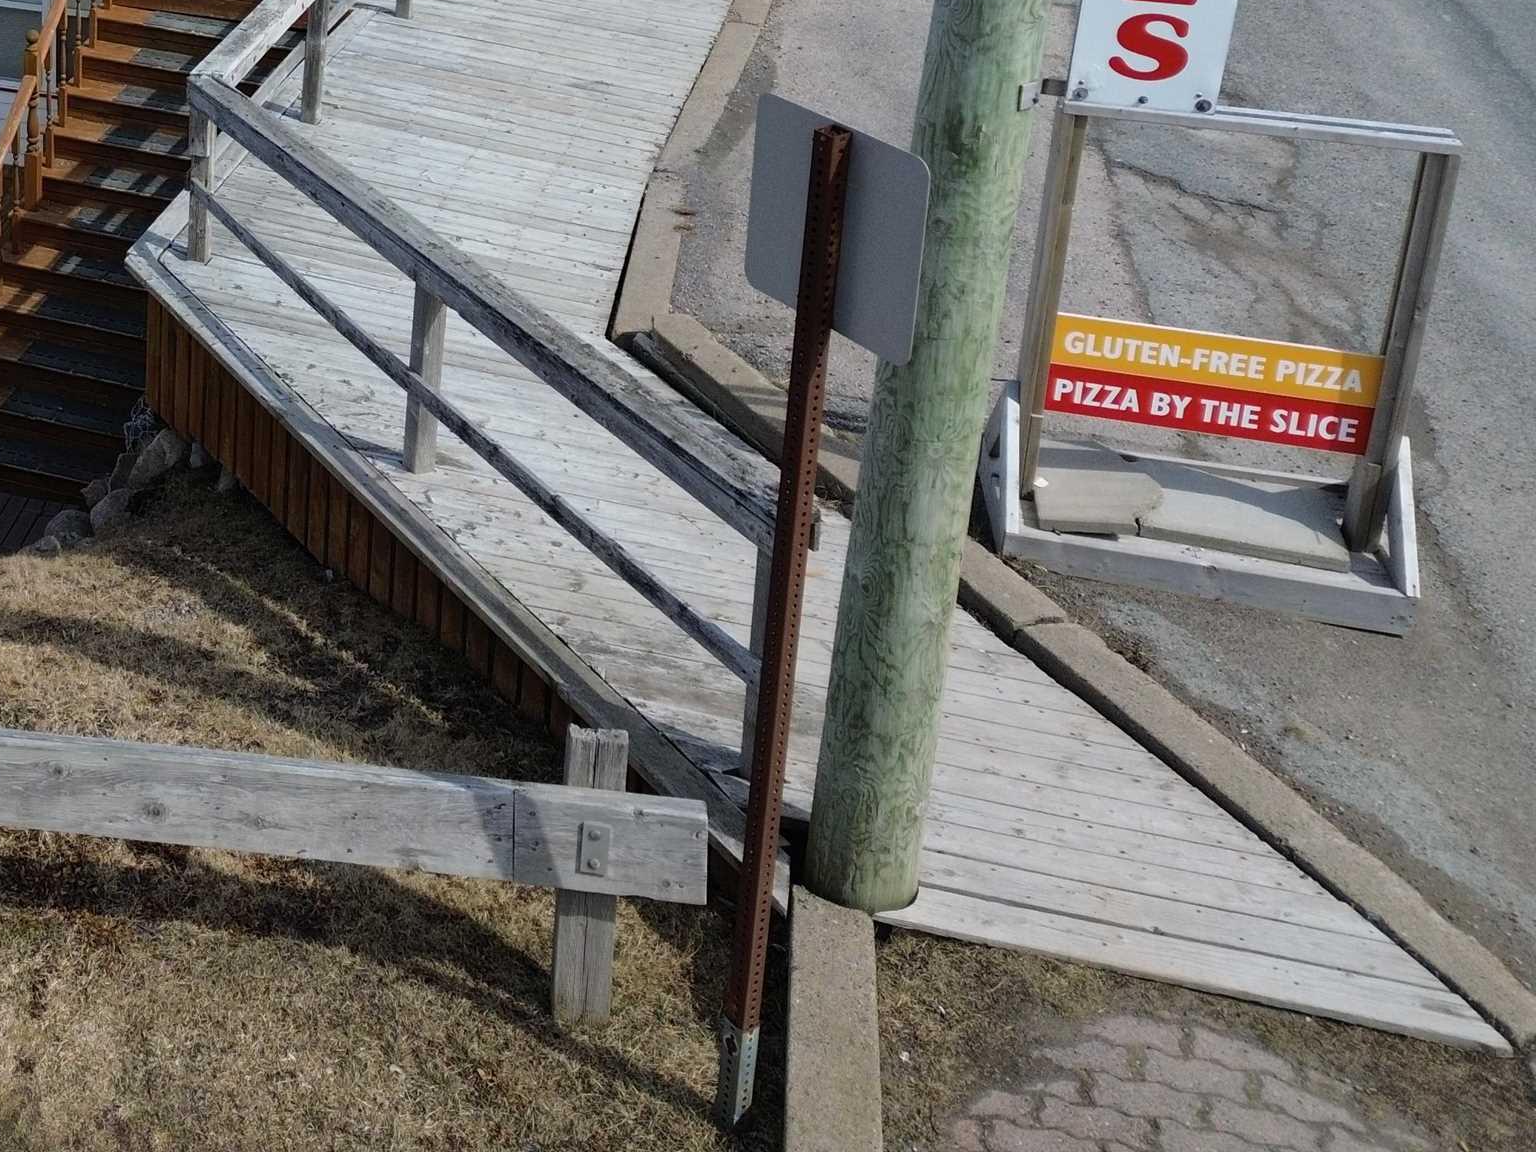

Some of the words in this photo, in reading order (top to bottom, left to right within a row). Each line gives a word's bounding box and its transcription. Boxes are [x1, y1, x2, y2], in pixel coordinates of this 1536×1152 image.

[1064, 331, 1267, 381] GLUTEN-FREE
[1275, 358, 1363, 393] PIZZA
[1052, 377, 1141, 414] PIZZA
[1150, 391, 1193, 419] BY
[1200, 398, 1263, 430] THE
[1269, 408, 1361, 444] SLICE
